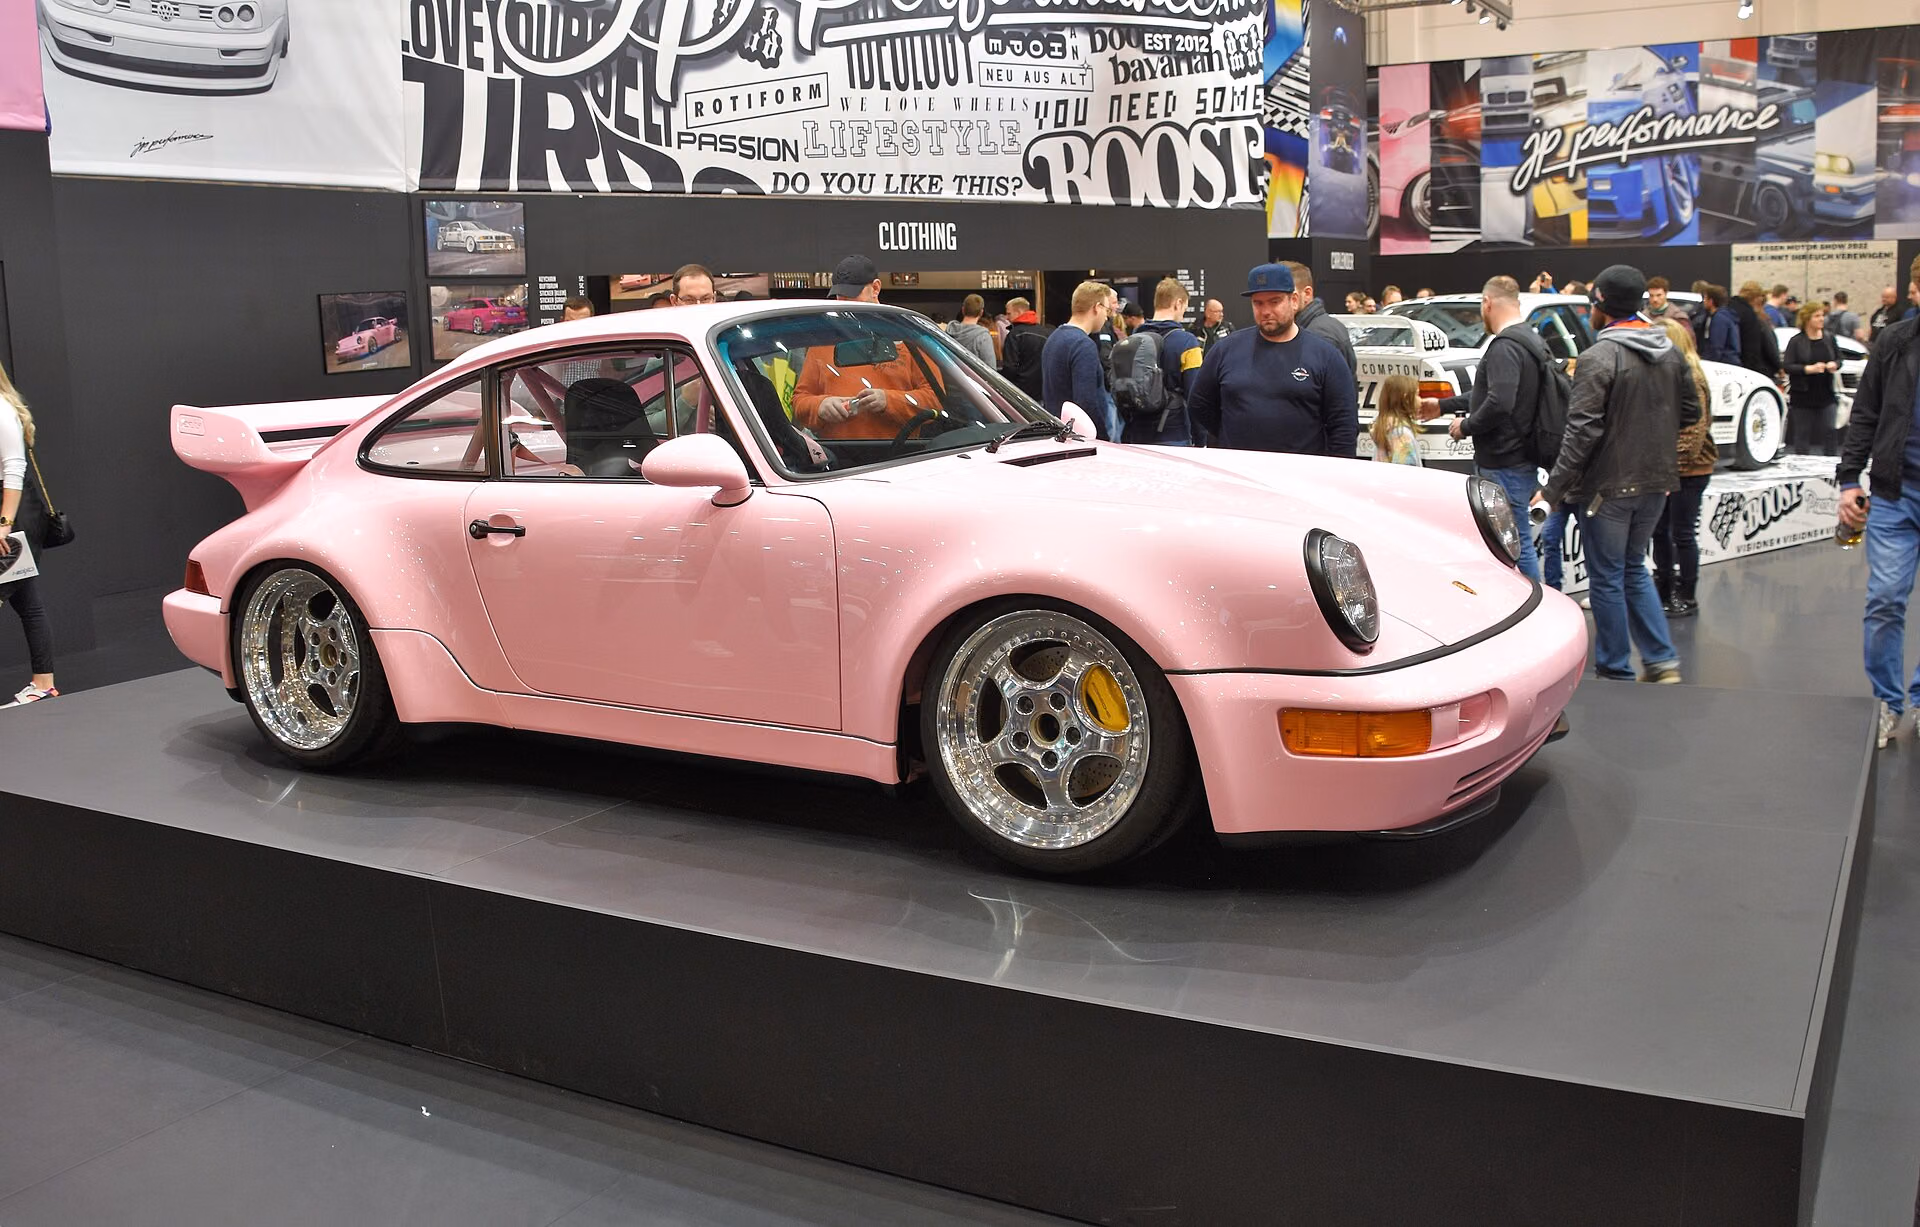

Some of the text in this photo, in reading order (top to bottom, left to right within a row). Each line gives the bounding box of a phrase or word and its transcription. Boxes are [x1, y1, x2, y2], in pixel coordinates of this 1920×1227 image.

[401, 0, 485, 72] OVE
[1144, 33, 1210, 52] EST 2012
[986, 68, 1087, 86] NEU AUS ALT
[1109, 50, 1225, 86] bavarian
[694, 82, 823, 118] ROTIFORM
[840, 96, 1030, 112] WE LOVE WHEELS
[1034, 84, 1265, 130] YOU NEED SOME
[677, 131, 799, 163] PASSION
[802, 119, 1022, 158] LIFESTYLE
[1568, 103, 1781, 179] performance
[1022, 114, 1266, 209] BOOST
[771, 171, 1023, 197] DO YOU LIKE THIS?
[878, 222, 957, 251] CLOTHING
[1362, 363, 1421, 377] COMPTON
[1737, 540, 1775, 554] VISIONS
[1783, 530, 1822, 544] VISIONS
